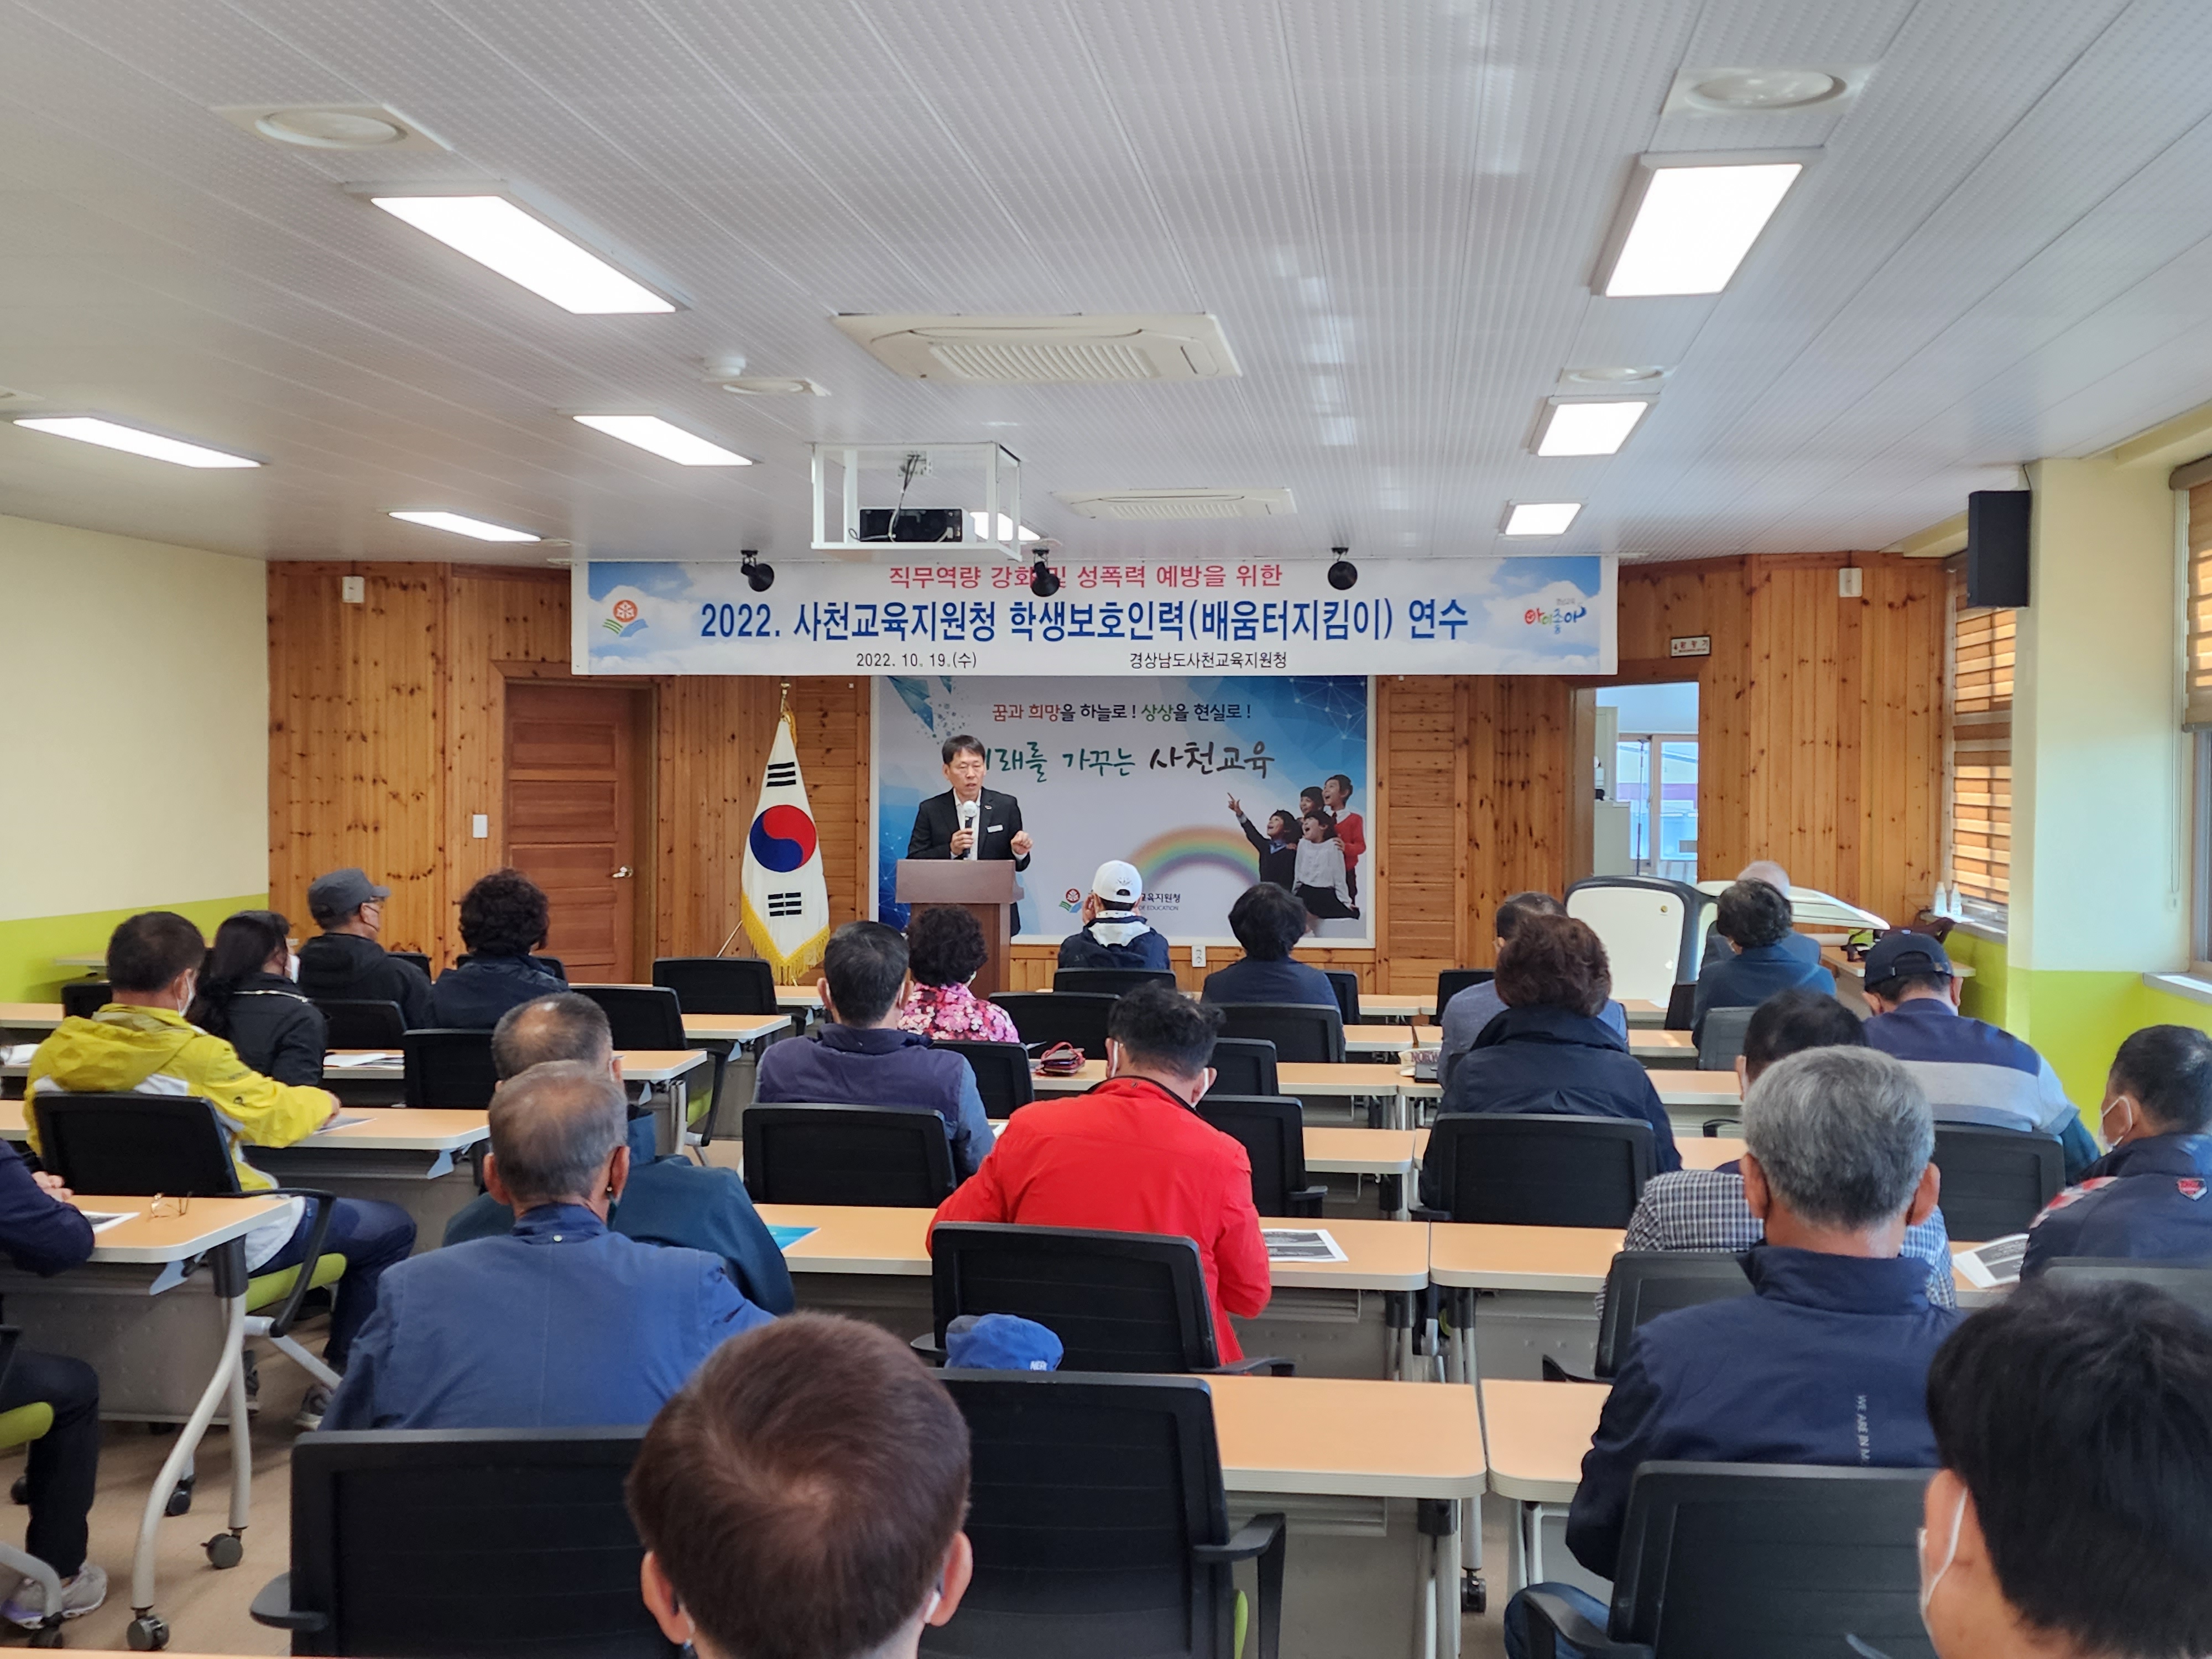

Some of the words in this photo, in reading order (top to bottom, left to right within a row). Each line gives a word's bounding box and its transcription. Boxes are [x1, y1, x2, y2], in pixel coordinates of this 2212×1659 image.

[889, 566, 981, 589] 직무역량
[1077, 565, 1145, 588] 성폭력
[1156, 565, 1226, 588] 예방을
[1236, 564, 1282, 587] 위한
[700, 603, 780, 638] 2022.
[793, 601, 995, 642] 사천교육지원청
[1009, 599, 1394, 642] 학생보호인력(배움터지킴이)
[1408, 598, 1469, 640] 연수
[856, 653, 895, 667] 2022.
[901, 653, 924, 667] 10.
[1130, 651, 1287, 669] 경상남도사천교육지원청
[992, 703, 1025, 722] 꿈과
[1027, 703, 1076, 722] 희망을
[1141, 703, 1190, 722] 상상을
[986, 741, 1048, 782] 래를
[1062, 747, 1136, 777] 가꾸는
[1149, 740, 1276, 780] 사천교육
